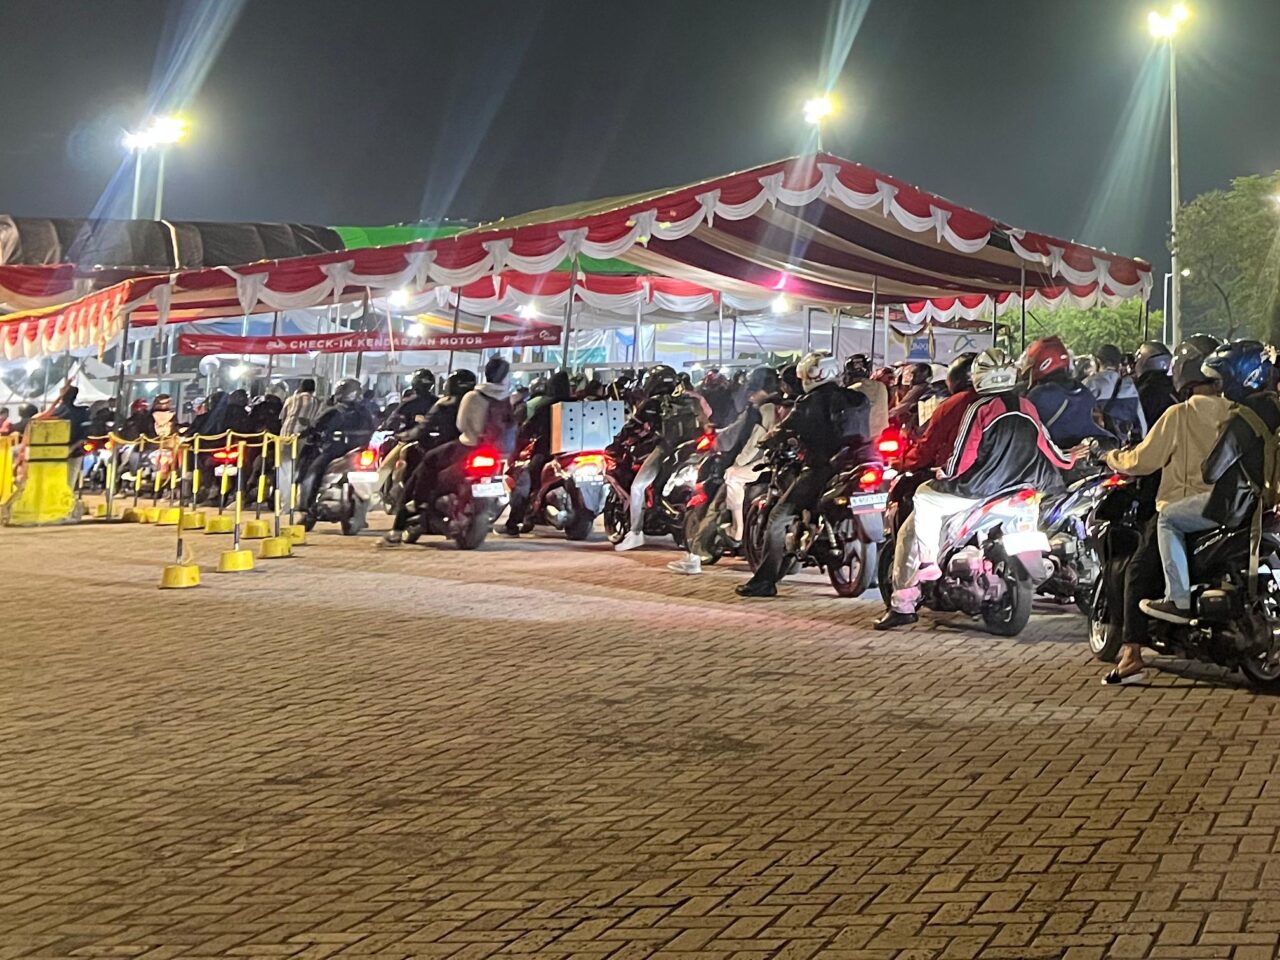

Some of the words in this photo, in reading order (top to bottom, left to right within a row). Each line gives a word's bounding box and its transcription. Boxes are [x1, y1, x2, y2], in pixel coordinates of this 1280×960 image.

[290, 339, 353, 350] CHECK-IN
[357, 338, 436, 347] KENDARAAN
[439, 337, 483, 346] MOTOR
